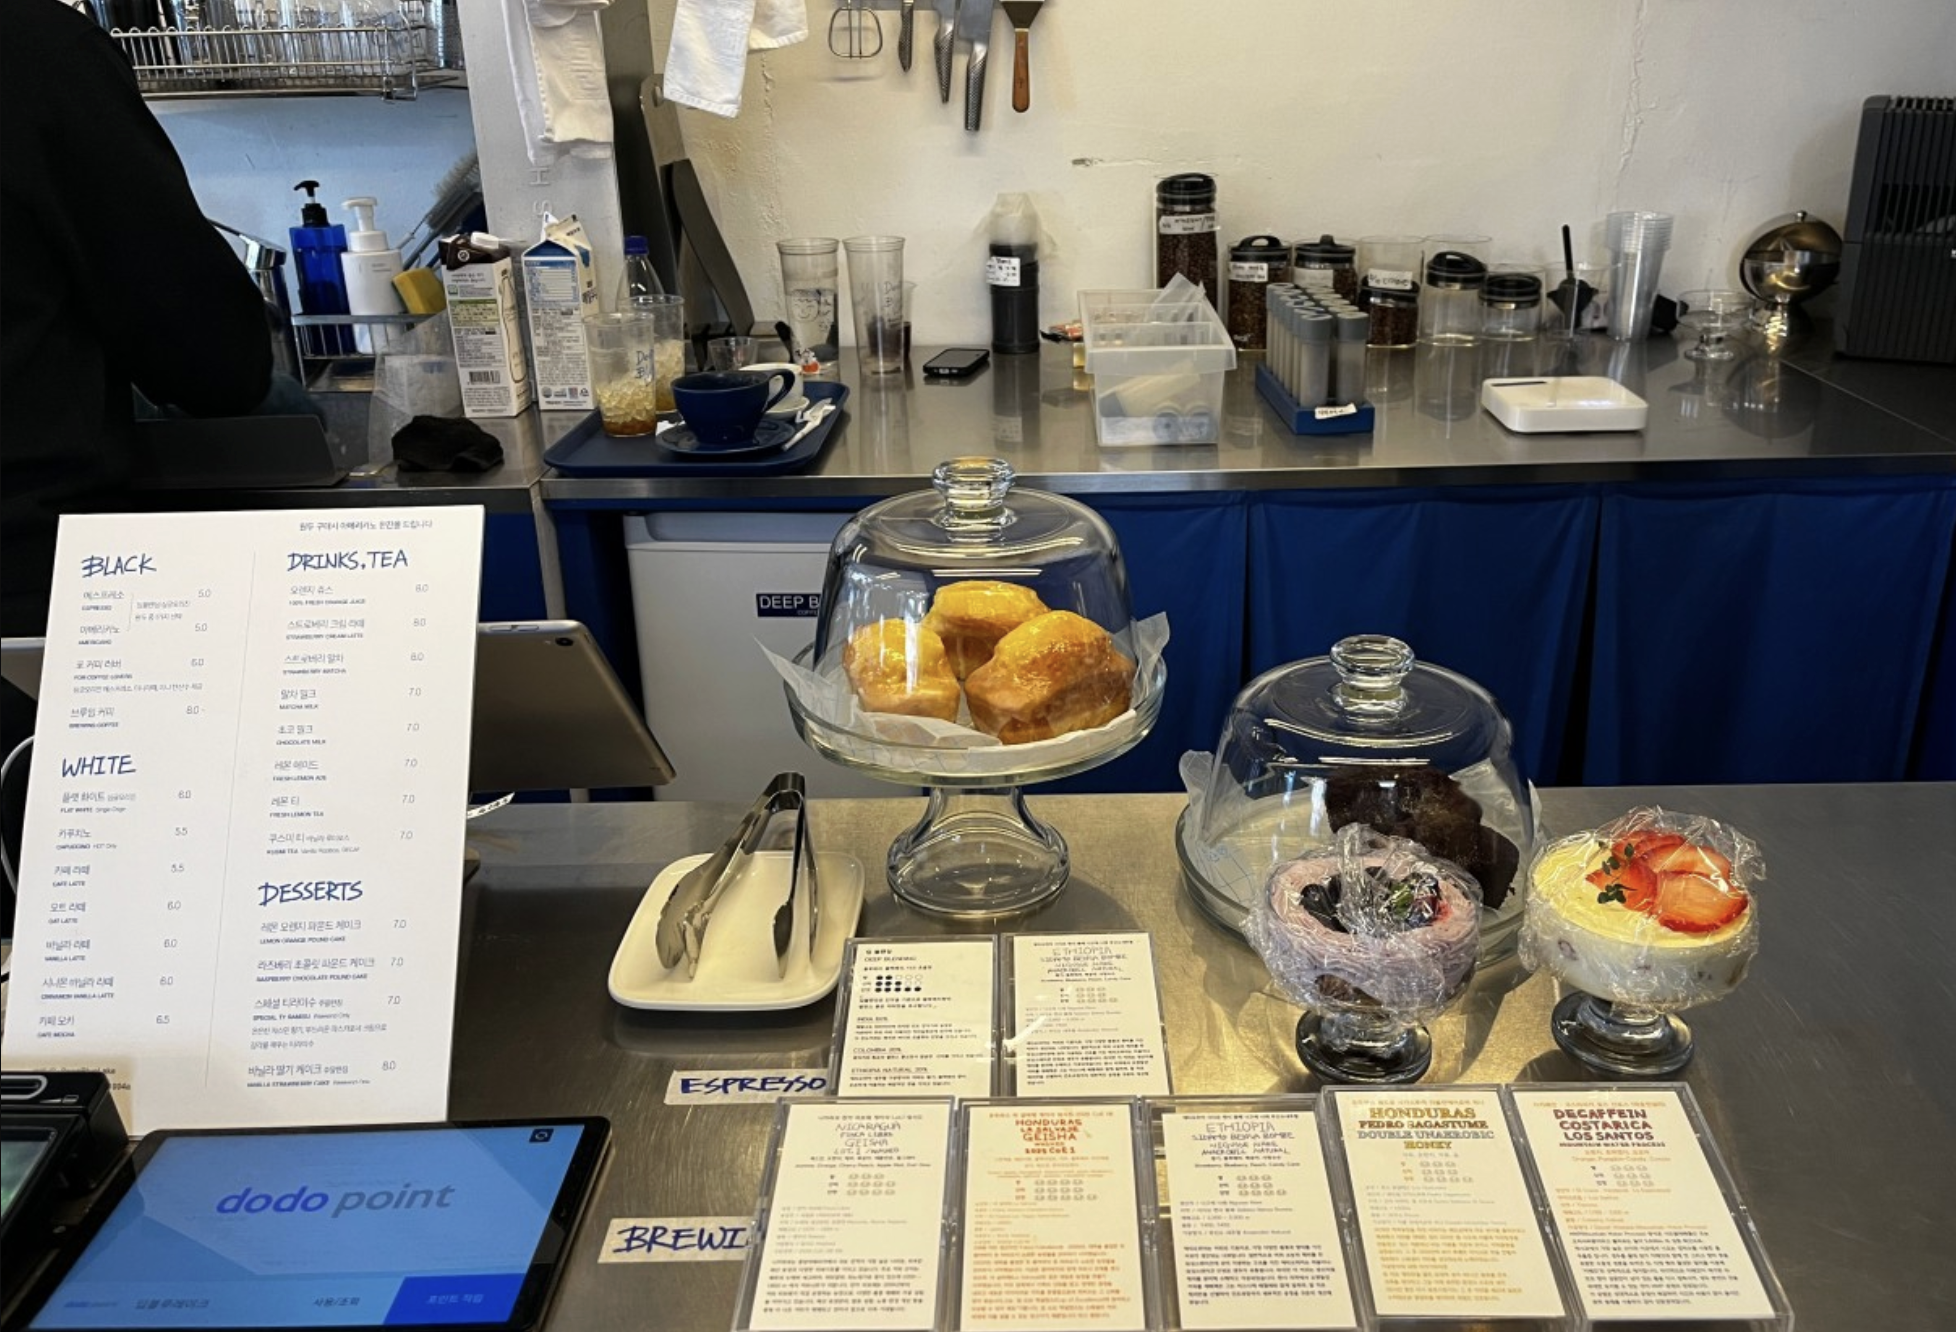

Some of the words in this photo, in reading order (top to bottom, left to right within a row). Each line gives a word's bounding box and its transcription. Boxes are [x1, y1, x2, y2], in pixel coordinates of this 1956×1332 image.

[81, 553, 157, 578] BLACK
[760, 595, 803, 609] DEEP
[409, 688, 421, 696] 7.0
[407, 723, 420, 732] 7.0
[61, 754, 137, 778] WHITE
[405, 758, 418, 767] 7.0
[402, 794, 415, 804] 7.0
[58, 828, 92, 838] 카푸치노
[400, 831, 413, 840] 7.0
[258, 880, 363, 907] DESSERTS
[393, 919, 407, 928] 7.0
[390, 957, 404, 967] 7.0
[387, 996, 401, 1005] 7.0
[156, 1015, 170, 1024] 6.5
[680, 1076, 827, 1095] ESPRESSO
[1369, 1107, 1476, 1119] HONDURAS
[1553, 1109, 1647, 1119] DECAFFEIN
[1206, 1121, 1275, 1132] ETHIOPIA
[1358, 1120, 1404, 1129] PEDRO
[1559, 1120, 1653, 1130] COSTARICA
[1023, 1133, 1077, 1141] GEISHA
[1357, 1130, 1412, 1139] DOUBLE
[1564, 1132, 1591, 1140] LOS
[1596, 1131, 1654, 1140] SANTOS
[1404, 1141, 1452, 1149] HONEY
[216, 1185, 330, 1214] dodo
[331, 1183, 456, 1218] point
